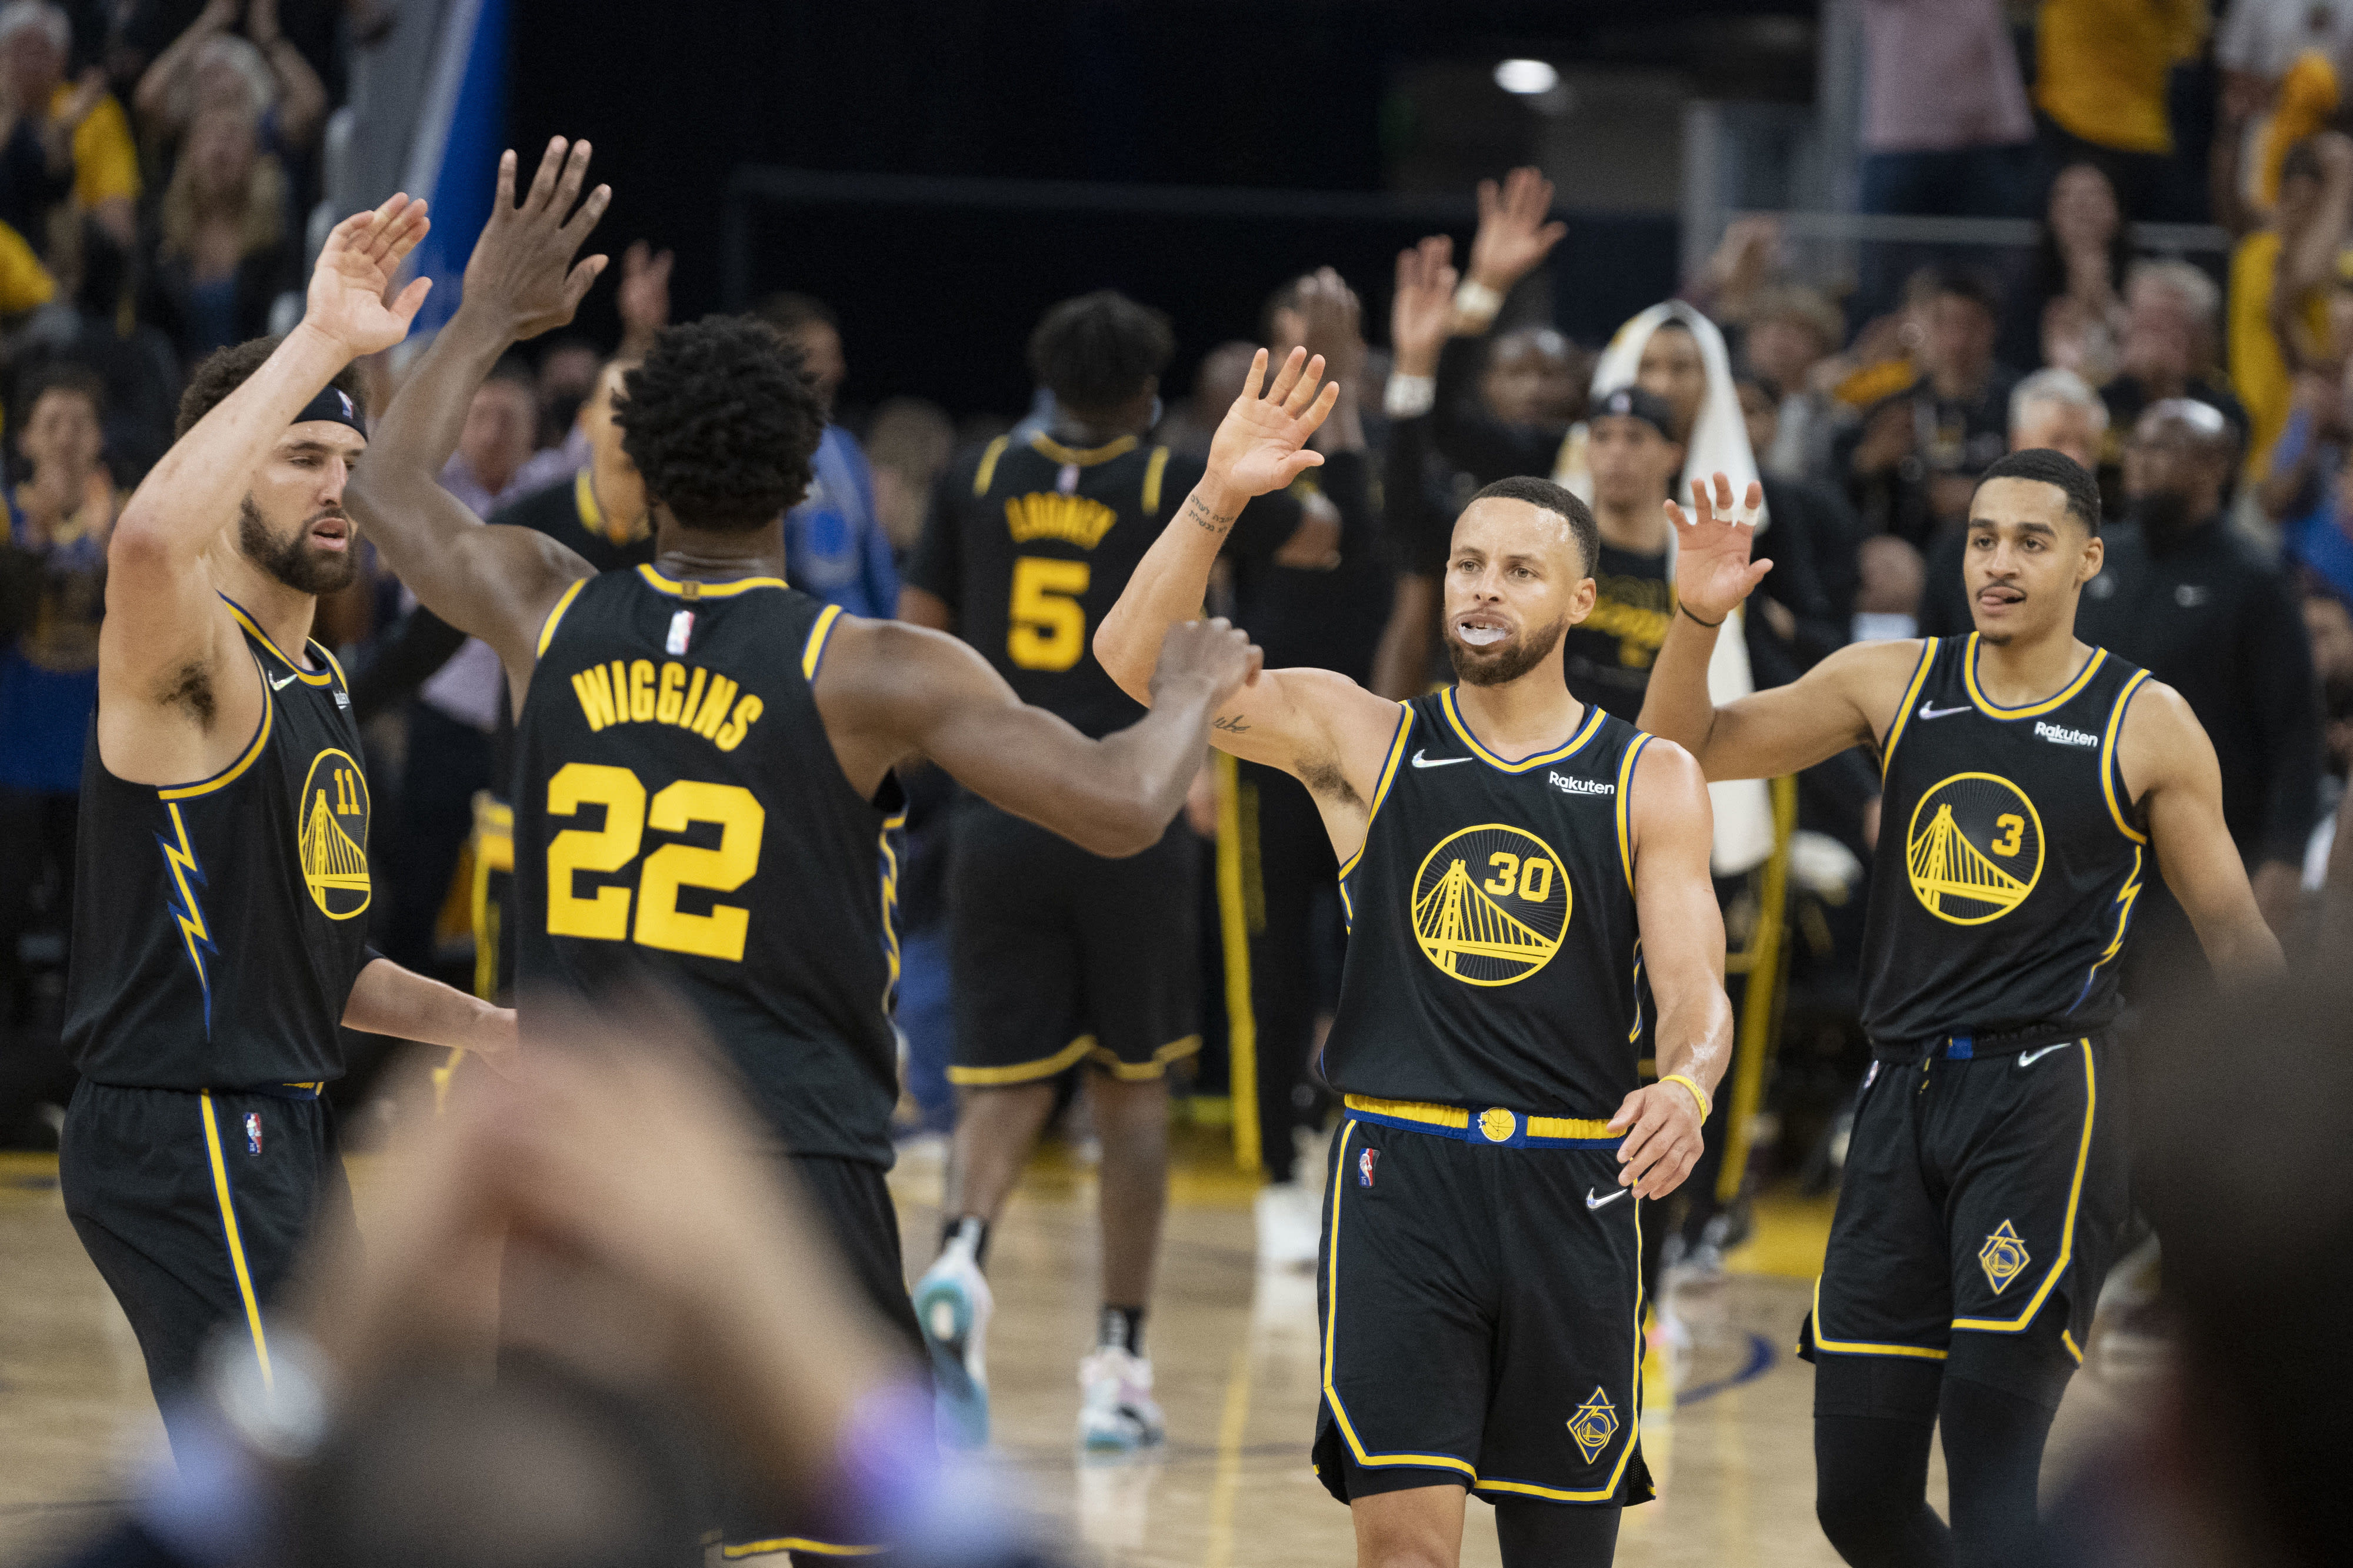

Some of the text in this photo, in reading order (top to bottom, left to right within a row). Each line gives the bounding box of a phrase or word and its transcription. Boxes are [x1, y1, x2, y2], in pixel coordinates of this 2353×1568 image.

[1008, 556, 1090, 672] 5
[571, 659, 764, 752] WIGGINS
[2034, 721, 2098, 748] Rakuten
[334, 768, 361, 815] 11
[1549, 770, 1615, 795] Rakuten
[1991, 813, 2025, 857] 3
[546, 762, 765, 962] 22
[1484, 851, 1554, 903] 30
